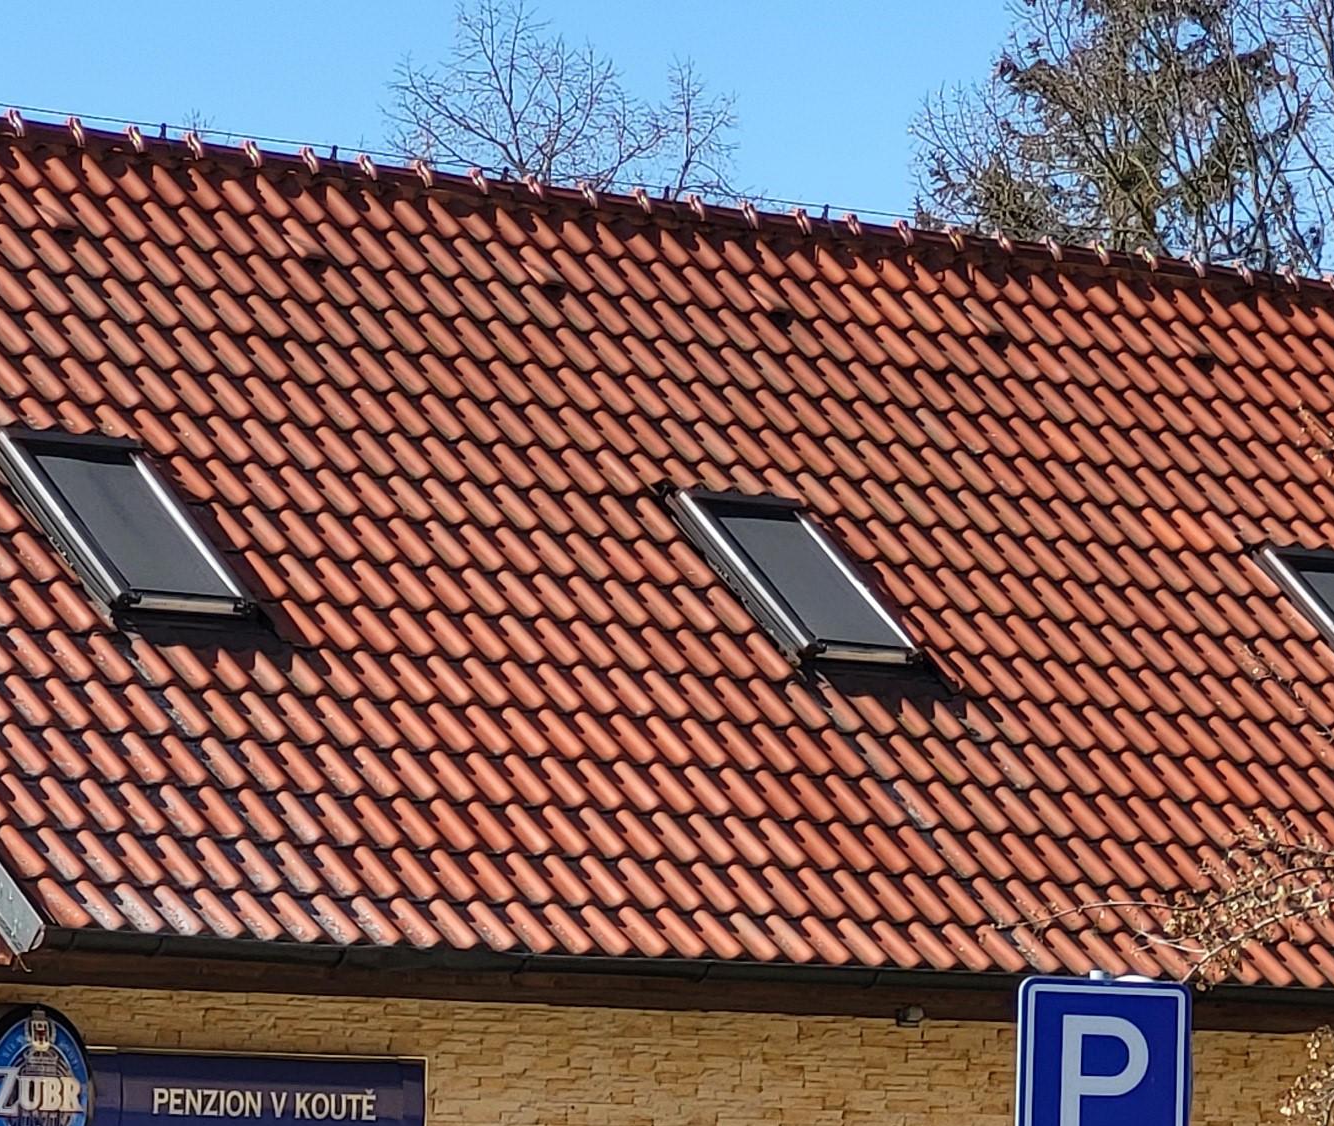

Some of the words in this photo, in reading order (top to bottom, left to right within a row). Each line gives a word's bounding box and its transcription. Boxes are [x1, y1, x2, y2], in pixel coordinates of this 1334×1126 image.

[153, 1088, 262, 1118] PENZION
[271, 1092, 287, 1118] V
[295, 1088, 377, 1121] KOUTĚ
